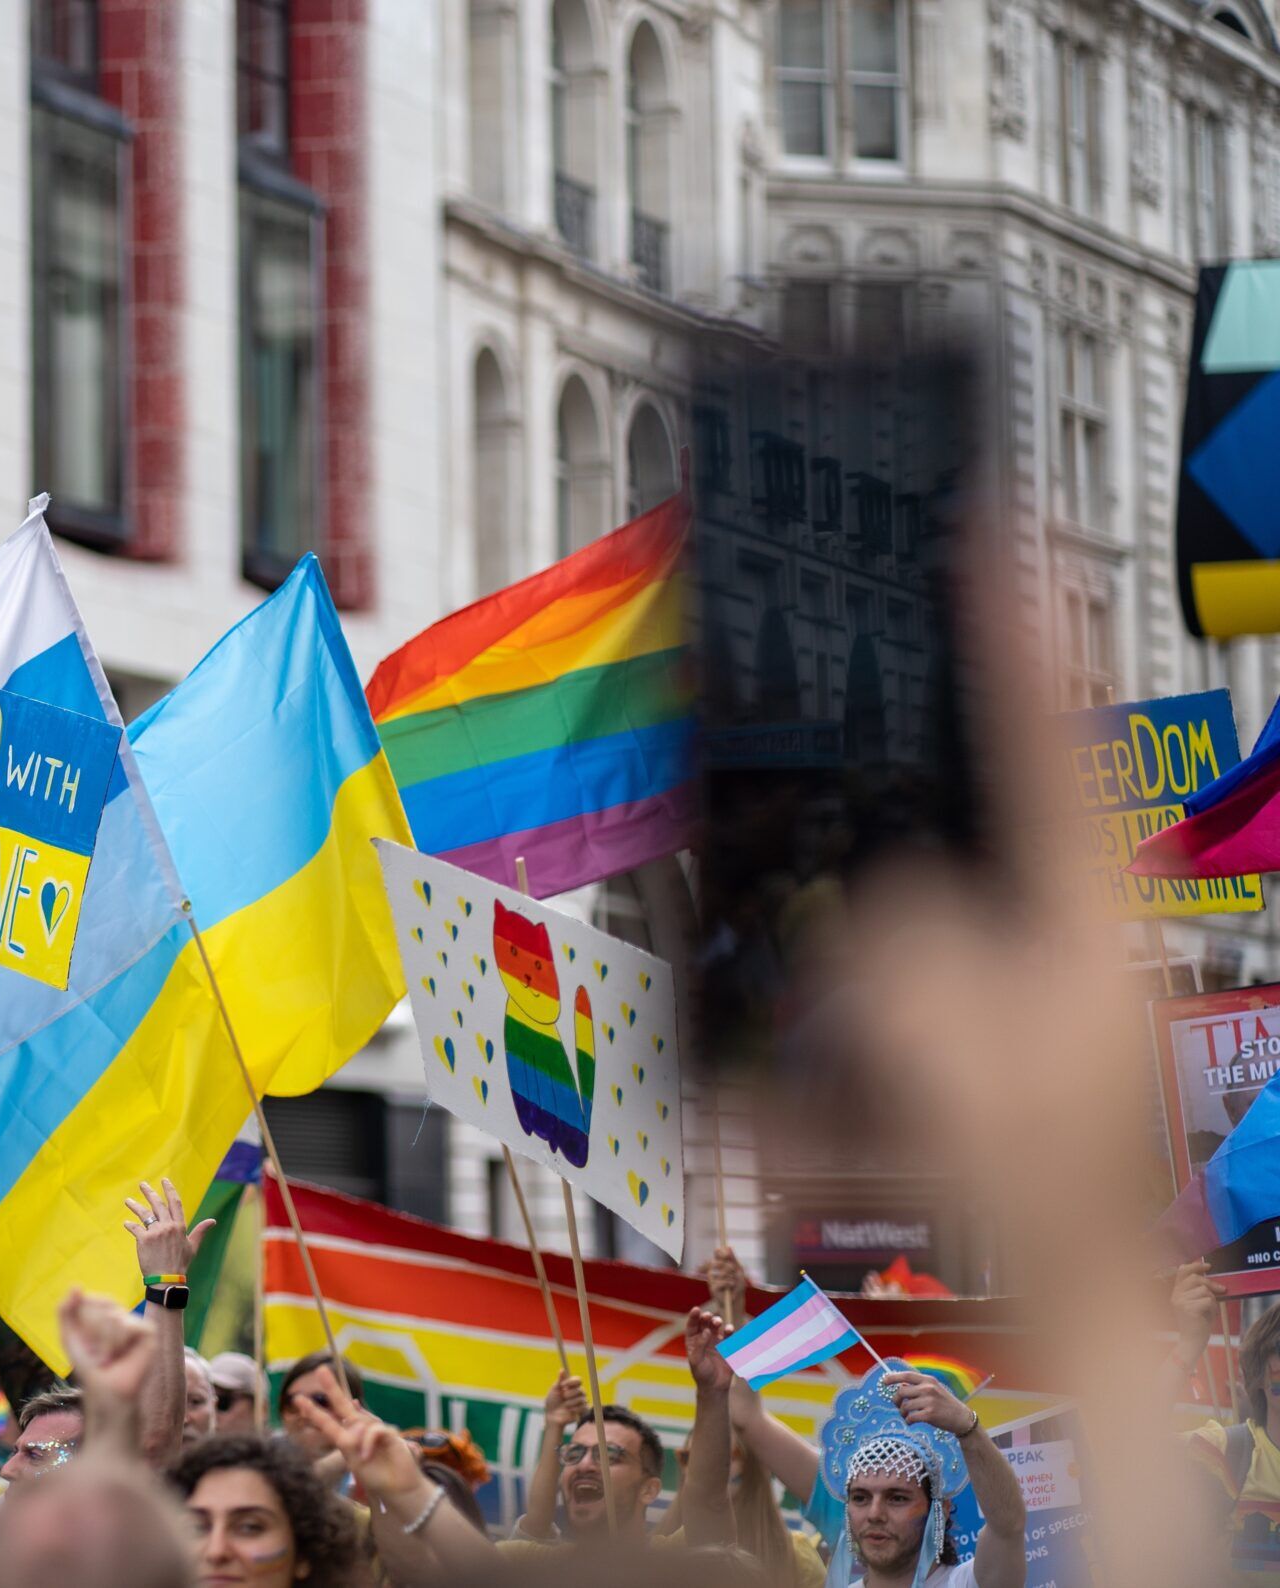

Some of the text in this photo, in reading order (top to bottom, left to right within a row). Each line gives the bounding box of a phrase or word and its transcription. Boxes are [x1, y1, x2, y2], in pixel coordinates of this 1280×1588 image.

[1070, 713, 1221, 807] EERDOM
[5, 744, 81, 814] WITH
[1240, 1037, 1280, 1060] STO
[1203, 1064, 1245, 1087] THE
[821, 1220, 930, 1248] NatWest
[1007, 1449, 1045, 1465] PEAK
[1026, 1471, 1054, 1484] WHEN
[1027, 1484, 1057, 1495] VOICE
[1031, 1526, 1047, 1540] OF
